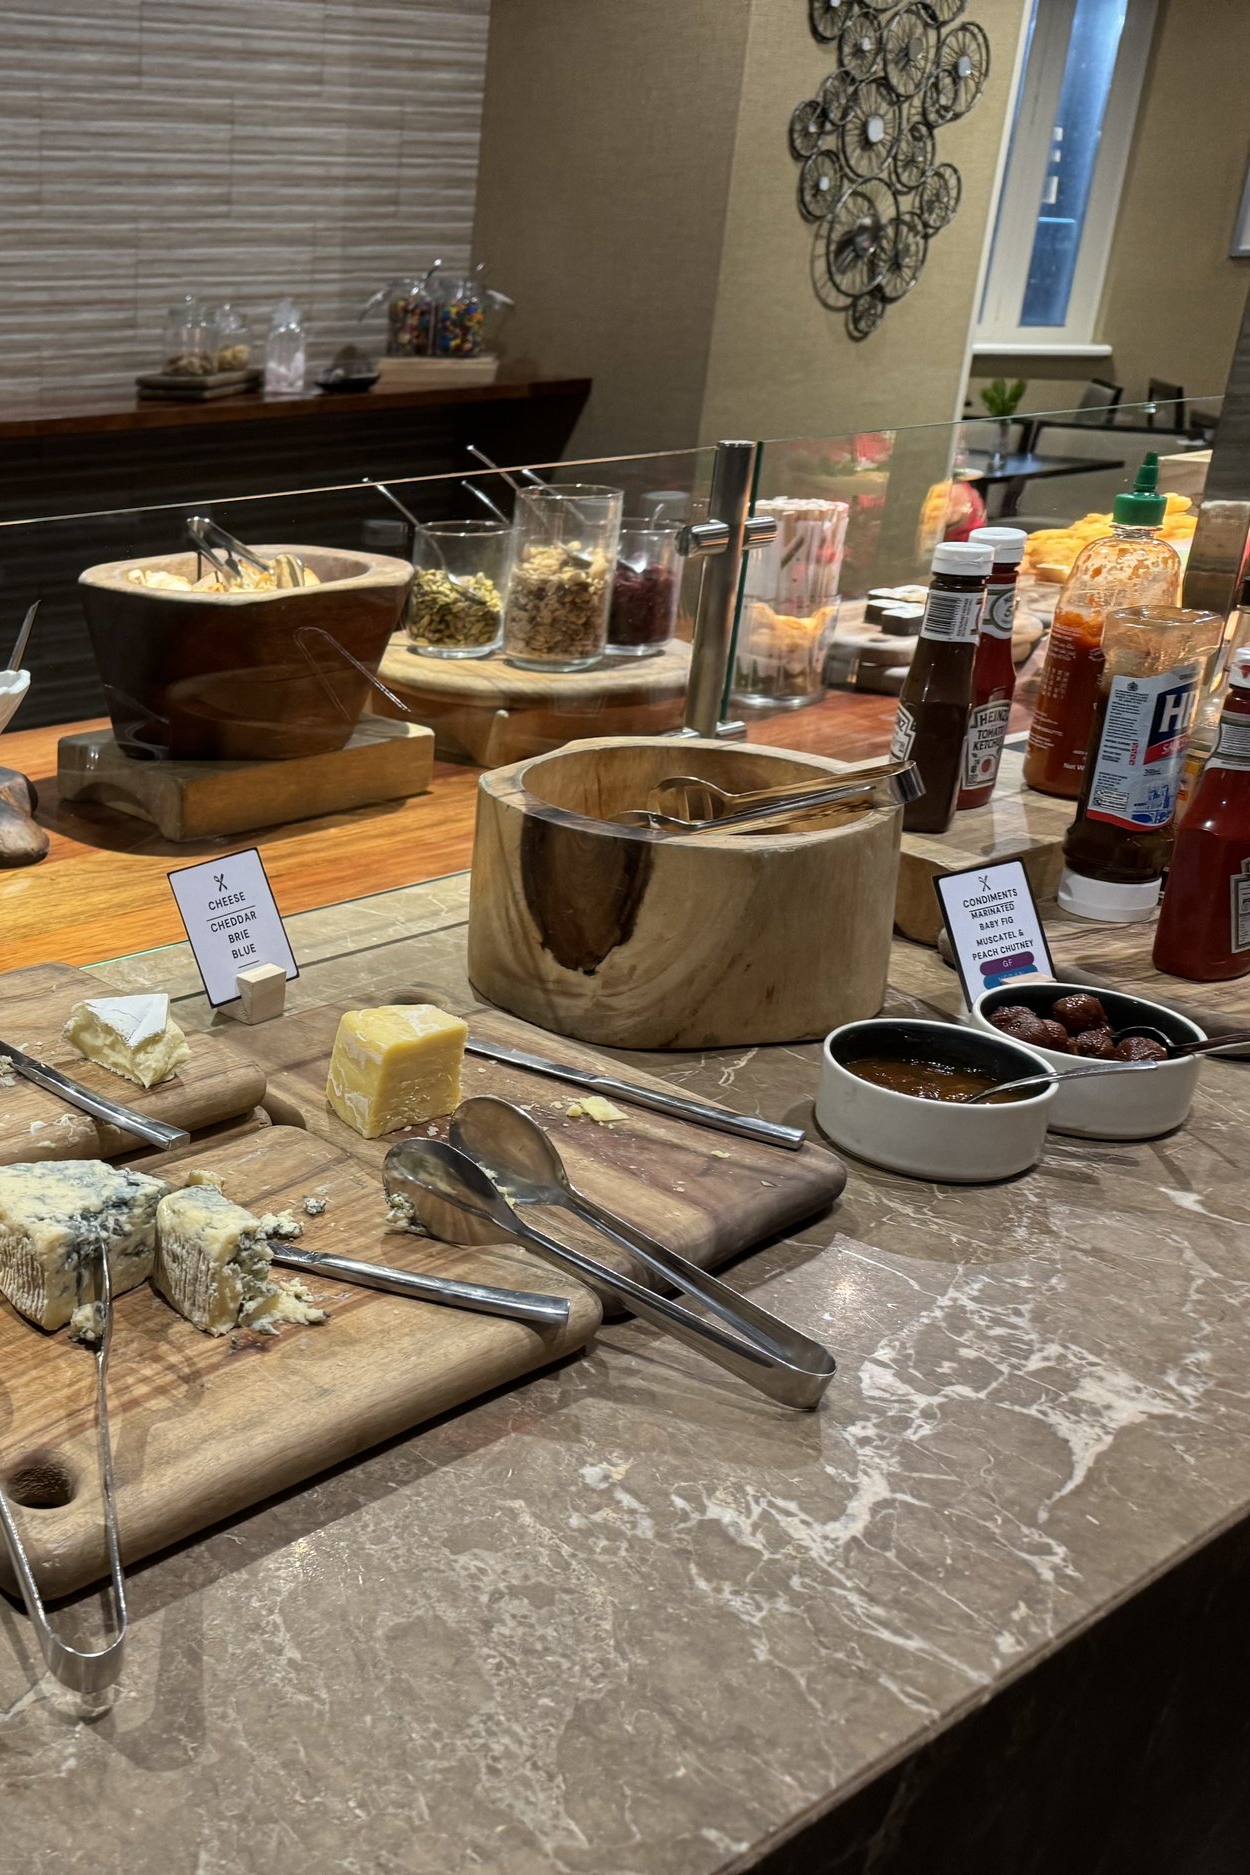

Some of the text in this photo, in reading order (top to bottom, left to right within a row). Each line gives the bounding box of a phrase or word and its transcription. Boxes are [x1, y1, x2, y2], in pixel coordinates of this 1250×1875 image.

[208, 891, 246, 911] CHEESE
[963, 888, 1018, 908] CONDIMENTS
[971, 903, 1015, 919] MARINATED
[210, 910, 257, 933] CHEDDAR
[979, 916, 1014, 931] BABY FIG
[228, 928, 250, 944] BRIE
[976, 929, 1025, 947] MUSCATEL &
[231, 943, 257, 959] BLUE
[972, 939, 1034, 961] PEACH CHUTNEY
[1002, 958, 1013, 967] GF
